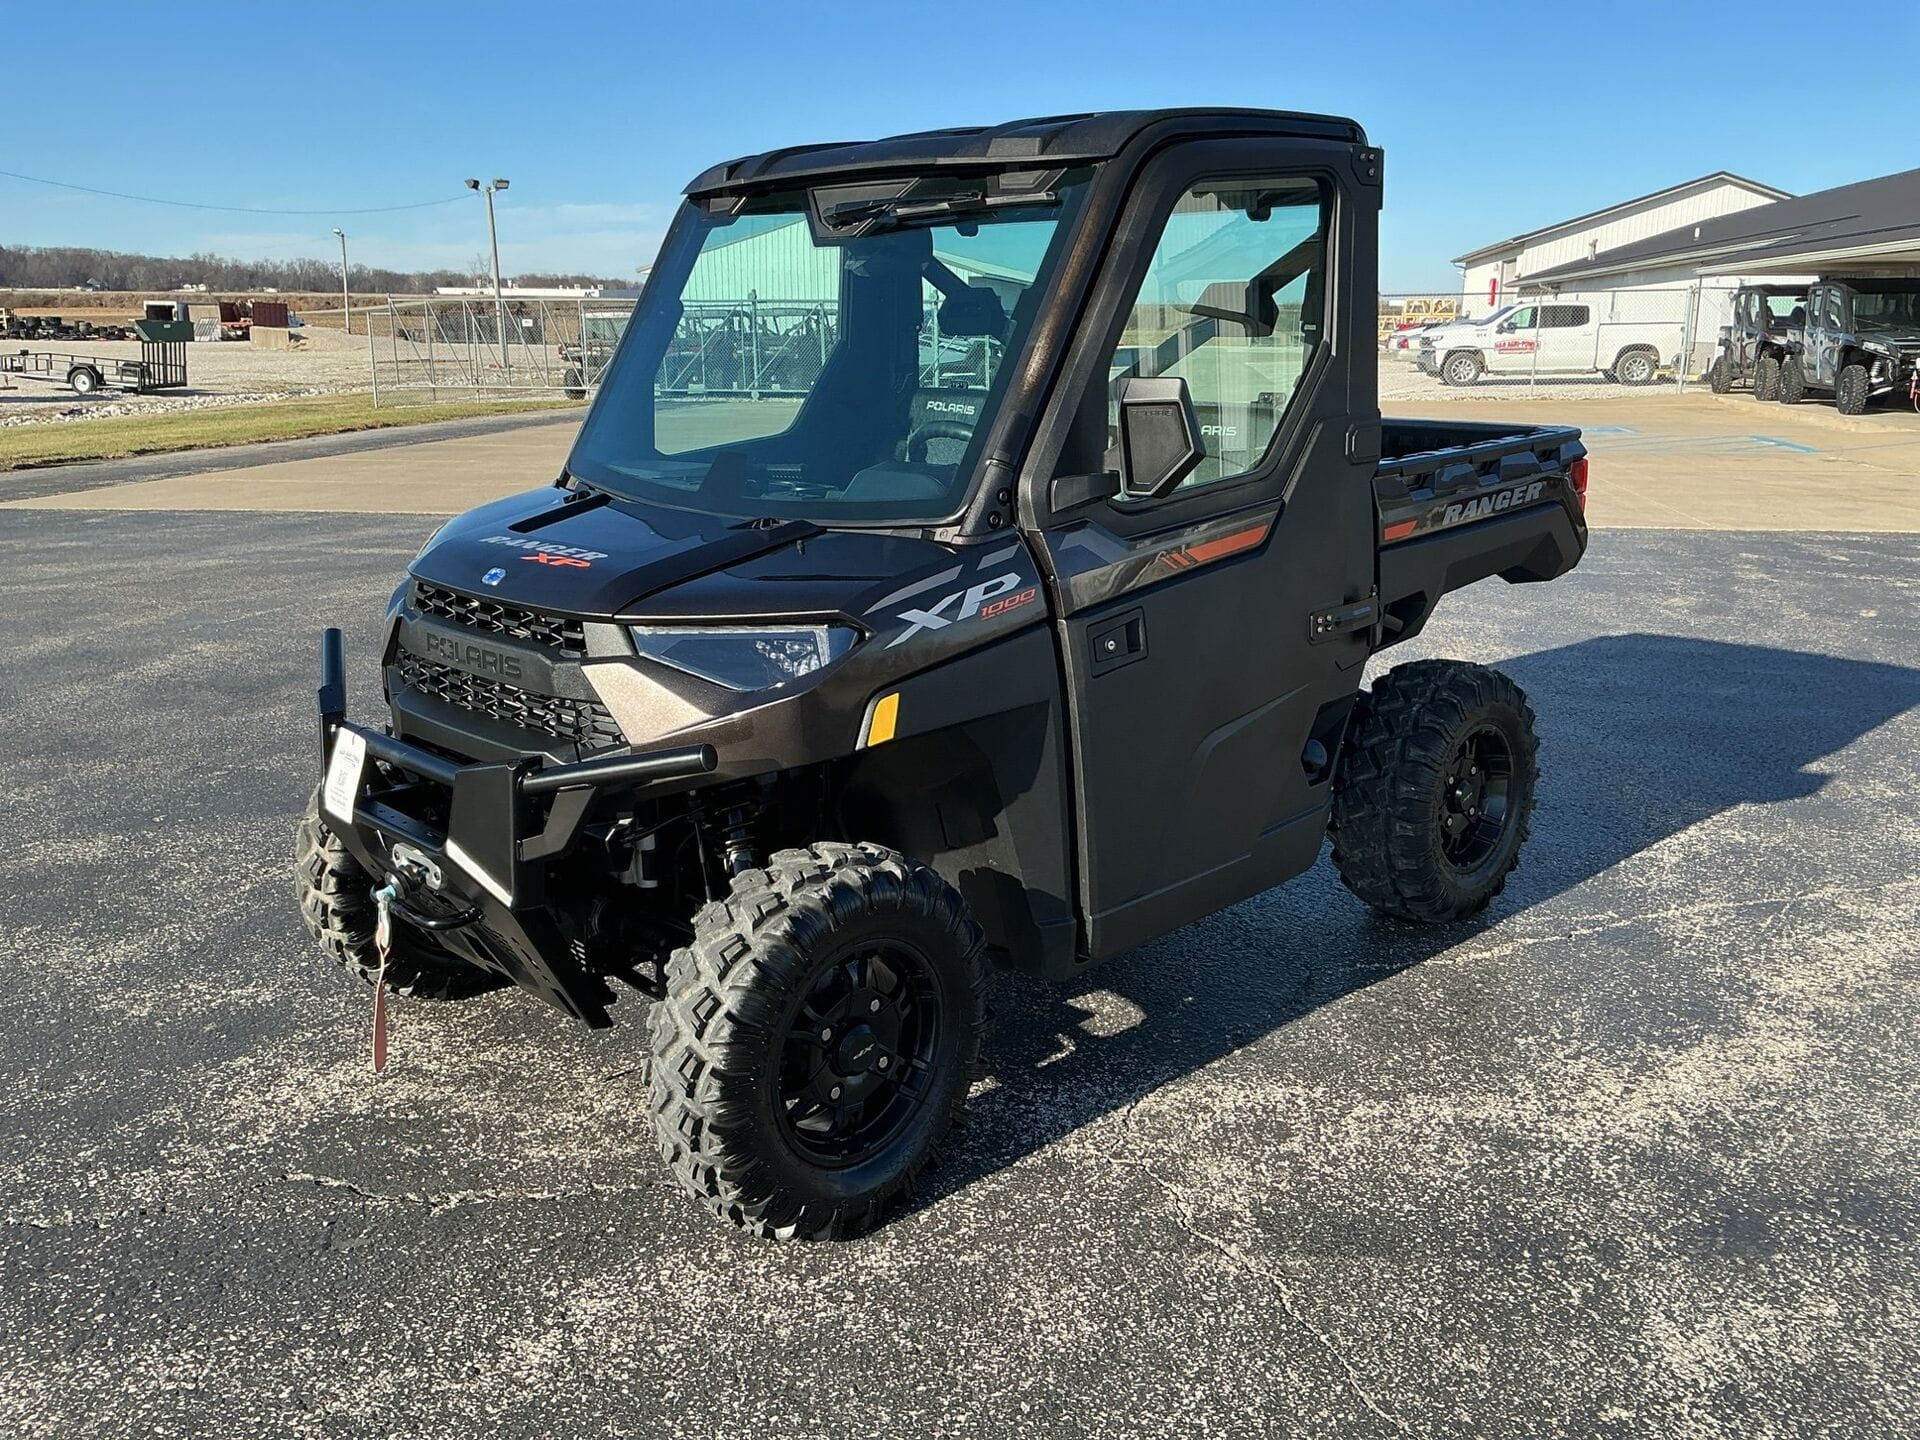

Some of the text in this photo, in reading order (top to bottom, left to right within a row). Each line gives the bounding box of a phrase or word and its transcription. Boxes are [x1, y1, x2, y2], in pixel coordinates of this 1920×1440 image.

[926, 400, 976, 415] POLARIS
[1200, 424, 1238, 437] ARIS
[1441, 481, 1544, 527] RANGER
[479, 535, 609, 561] RANGER
[520, 552, 592, 568] XP
[882, 571, 1022, 650] XP
[980, 588, 1036, 618] 1000
[426, 632, 522, 679] POLARIS
